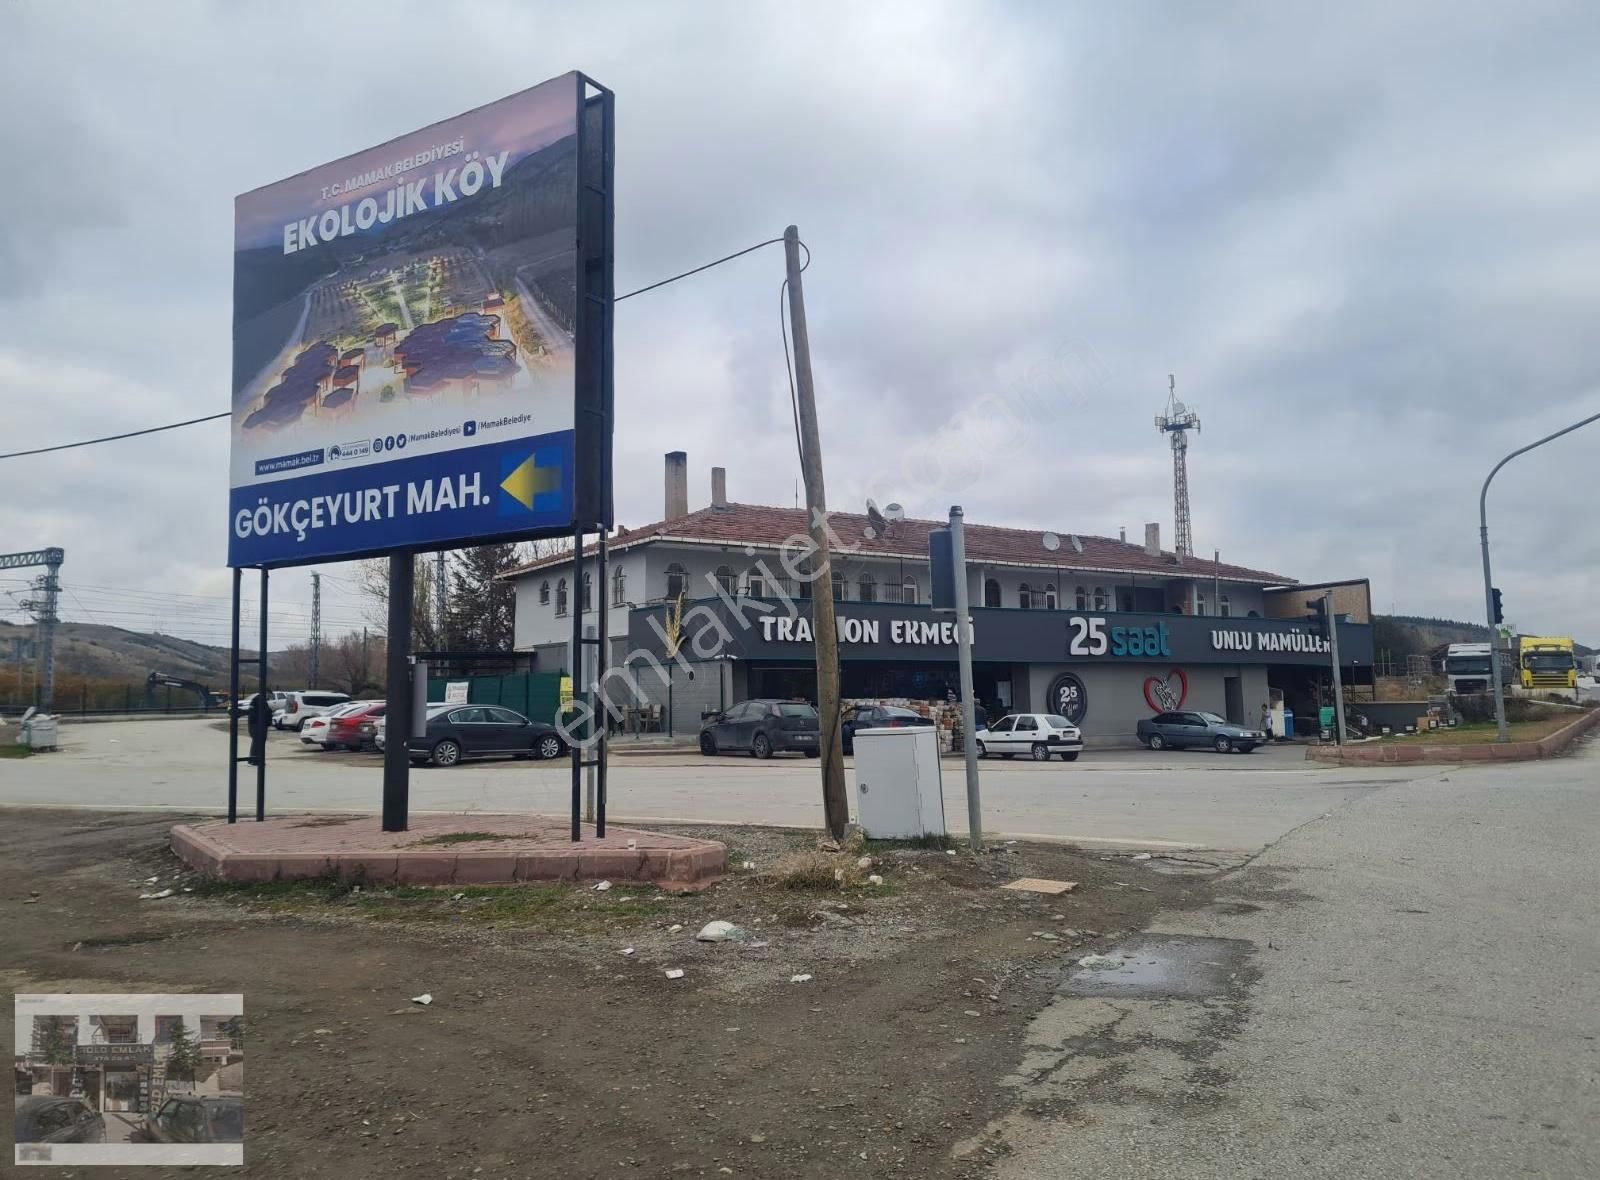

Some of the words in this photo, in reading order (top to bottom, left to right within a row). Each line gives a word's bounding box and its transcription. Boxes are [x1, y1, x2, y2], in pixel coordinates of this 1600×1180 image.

[320, 183, 343, 200] T.C.
[345, 165, 394, 193] MAMAK
[394, 136, 465, 174] BELEDİYESİ
[283, 177, 428, 255] EKOLOJİK
[434, 151, 511, 206] KÖY
[258, 453, 320, 473] www.mamak.bel.tr
[234, 484, 400, 542] GÖKÇEYURT
[407, 472, 491, 515] MAH.
[758, 616, 879, 643] TRAON
[1069, 616, 1108, 656] 25
[1111, 621, 1170, 656] saat
[1211, 630, 1253, 650] UNLU
[1060, 686, 1078, 702] 25
